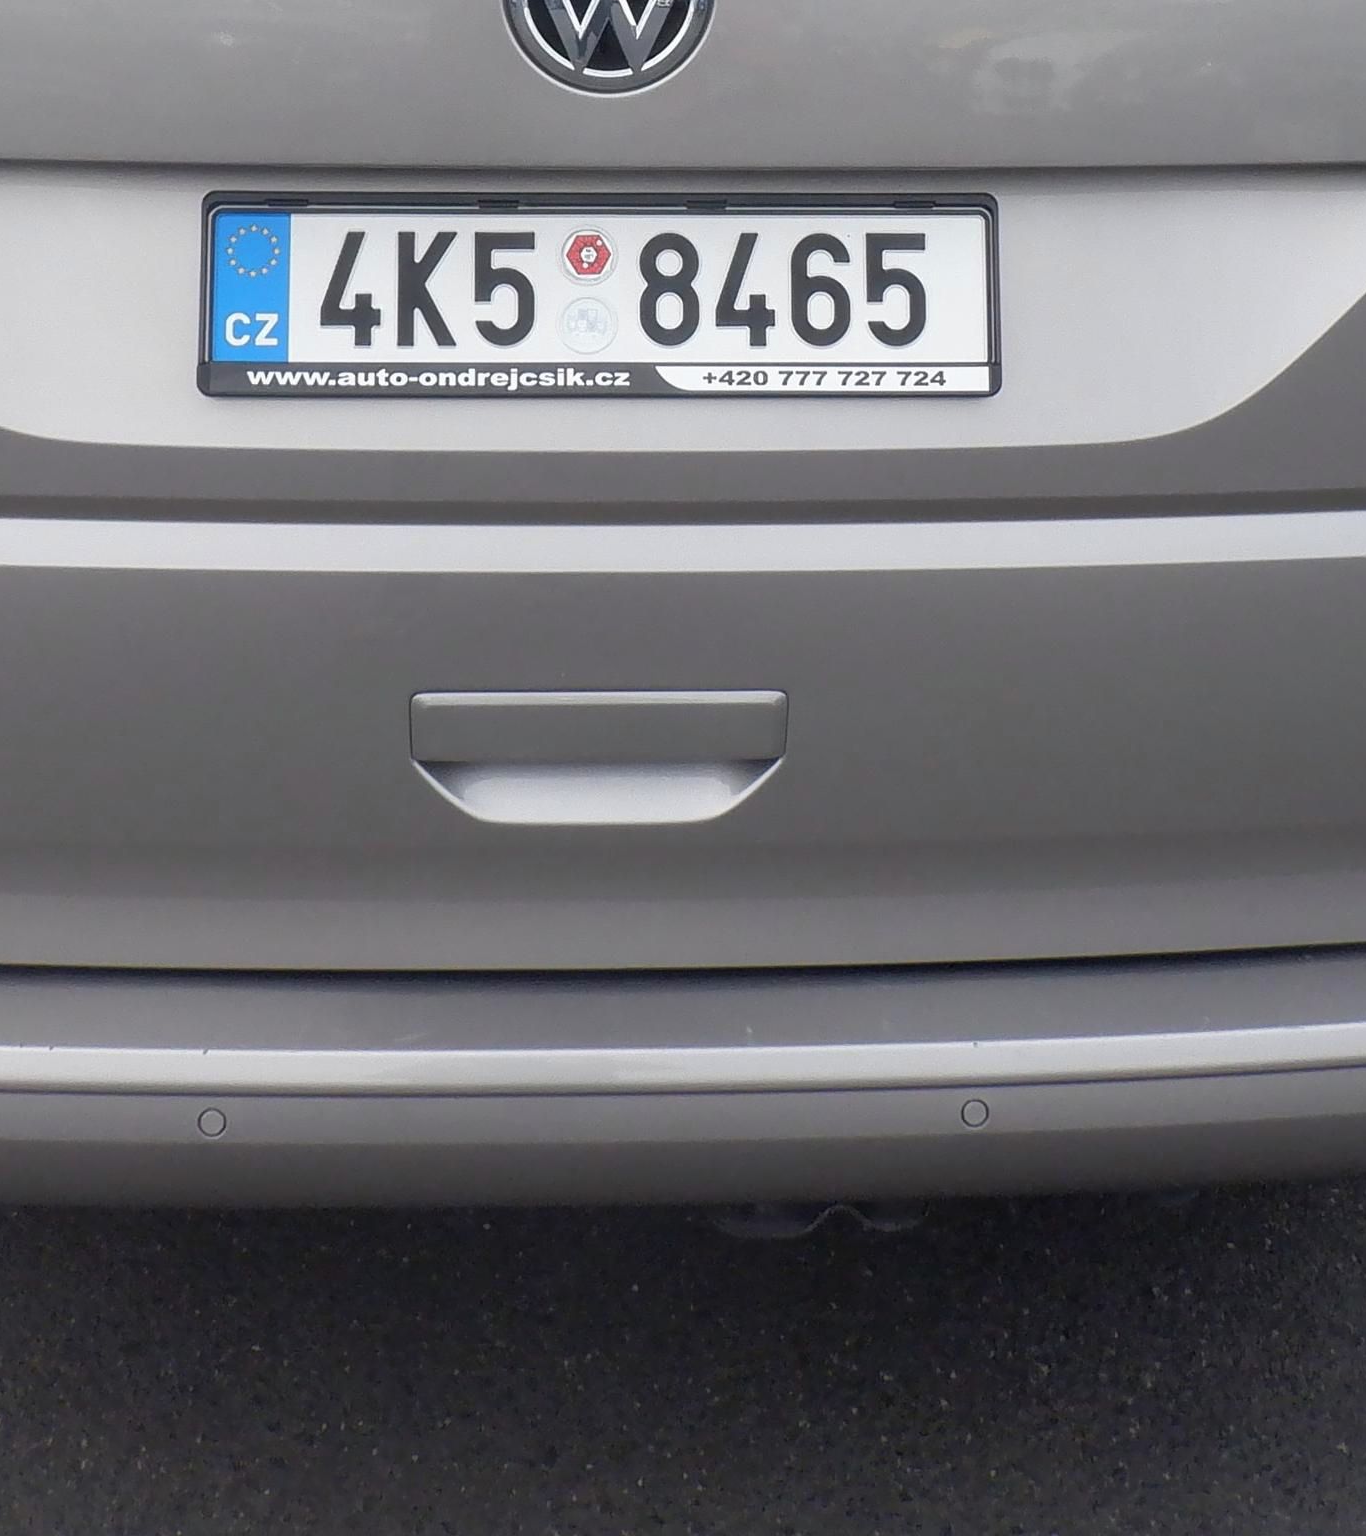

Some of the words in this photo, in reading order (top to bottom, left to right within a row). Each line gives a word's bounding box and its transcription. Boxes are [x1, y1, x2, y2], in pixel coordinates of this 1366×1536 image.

[320, 231, 536, 348] 4K5
[639, 232, 927, 348] 8465
[225, 312, 280, 347] CZ
[246, 368, 631, 390] www.auto-ondrejcsik.cz
[702, 370, 769, 387] +420
[778, 370, 828, 386] 777
[837, 370, 887, 386] 727
[896, 370, 947, 386] 724
